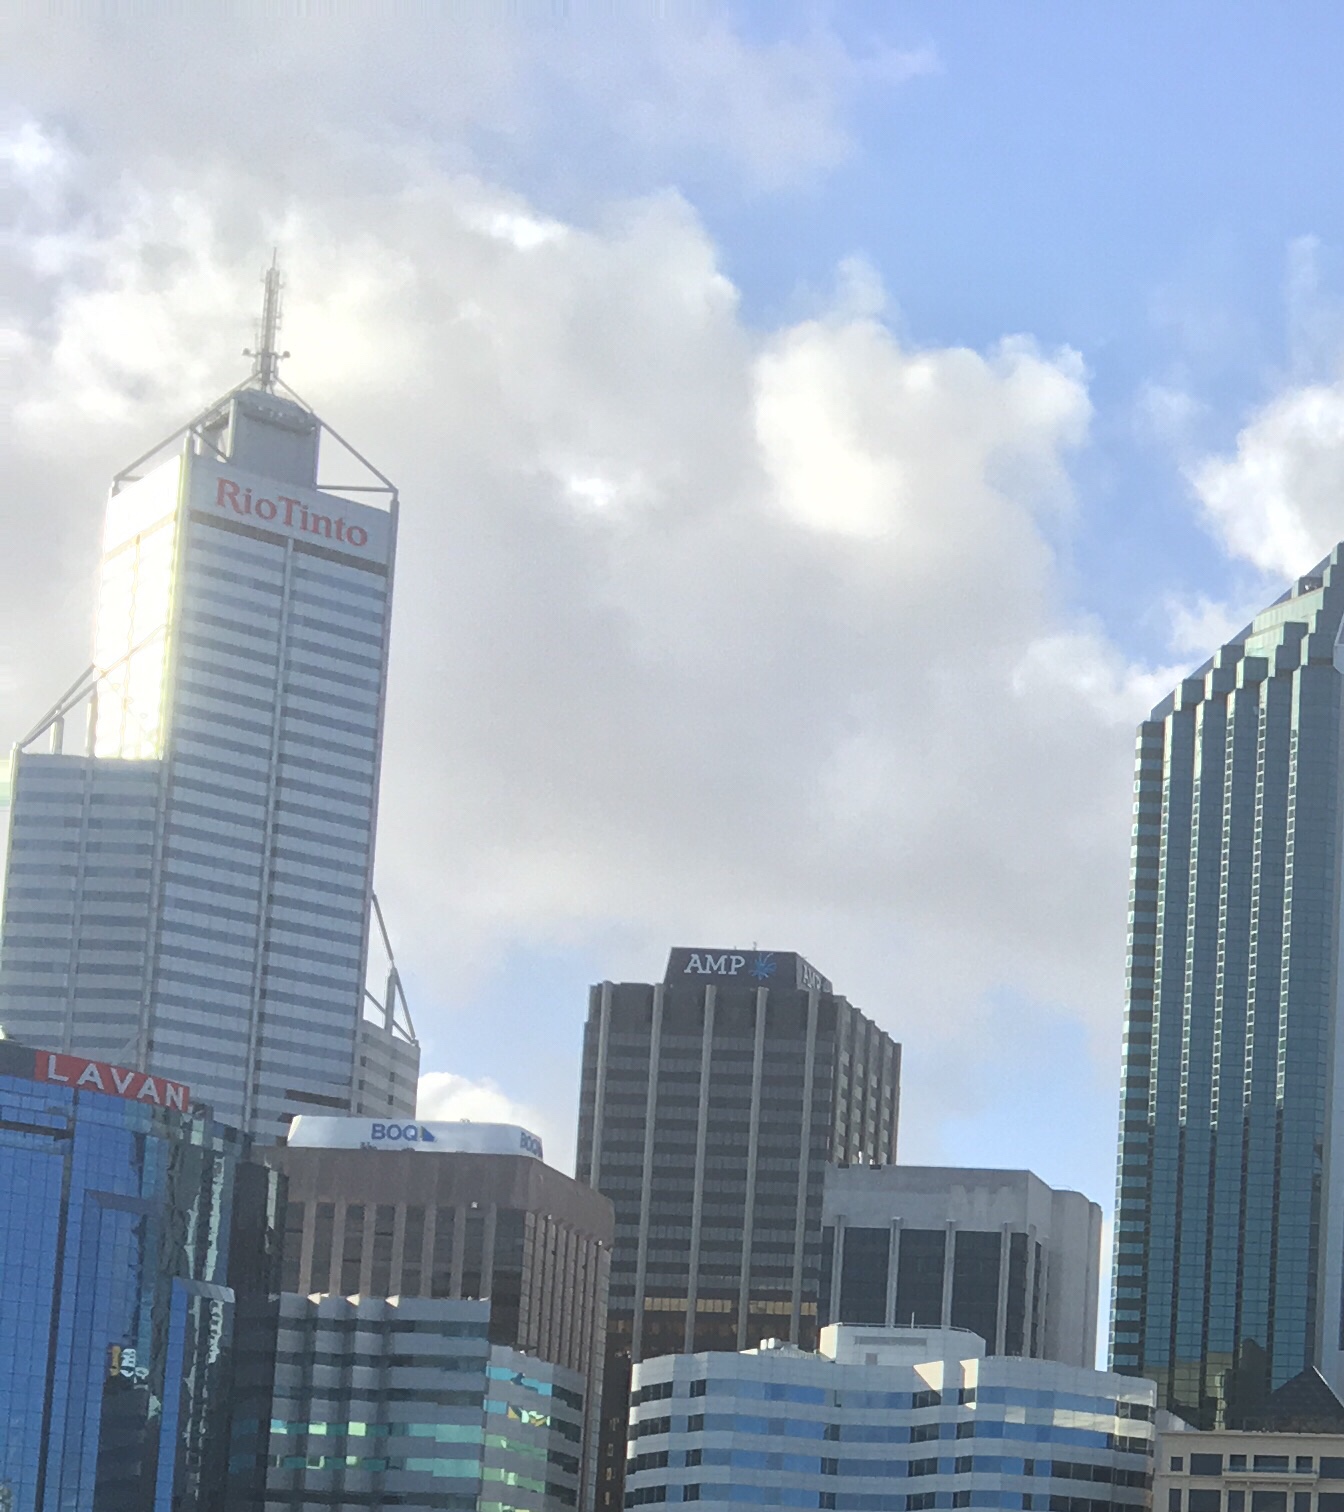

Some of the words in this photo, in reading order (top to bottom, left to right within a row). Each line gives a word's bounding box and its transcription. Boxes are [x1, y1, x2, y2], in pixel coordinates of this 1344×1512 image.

[683, 953, 746, 975] AMP
[803, 964, 822, 991] AMP
[48, 1054, 184, 1110] LAVAN
[371, 1123, 419, 1142] BOQ
